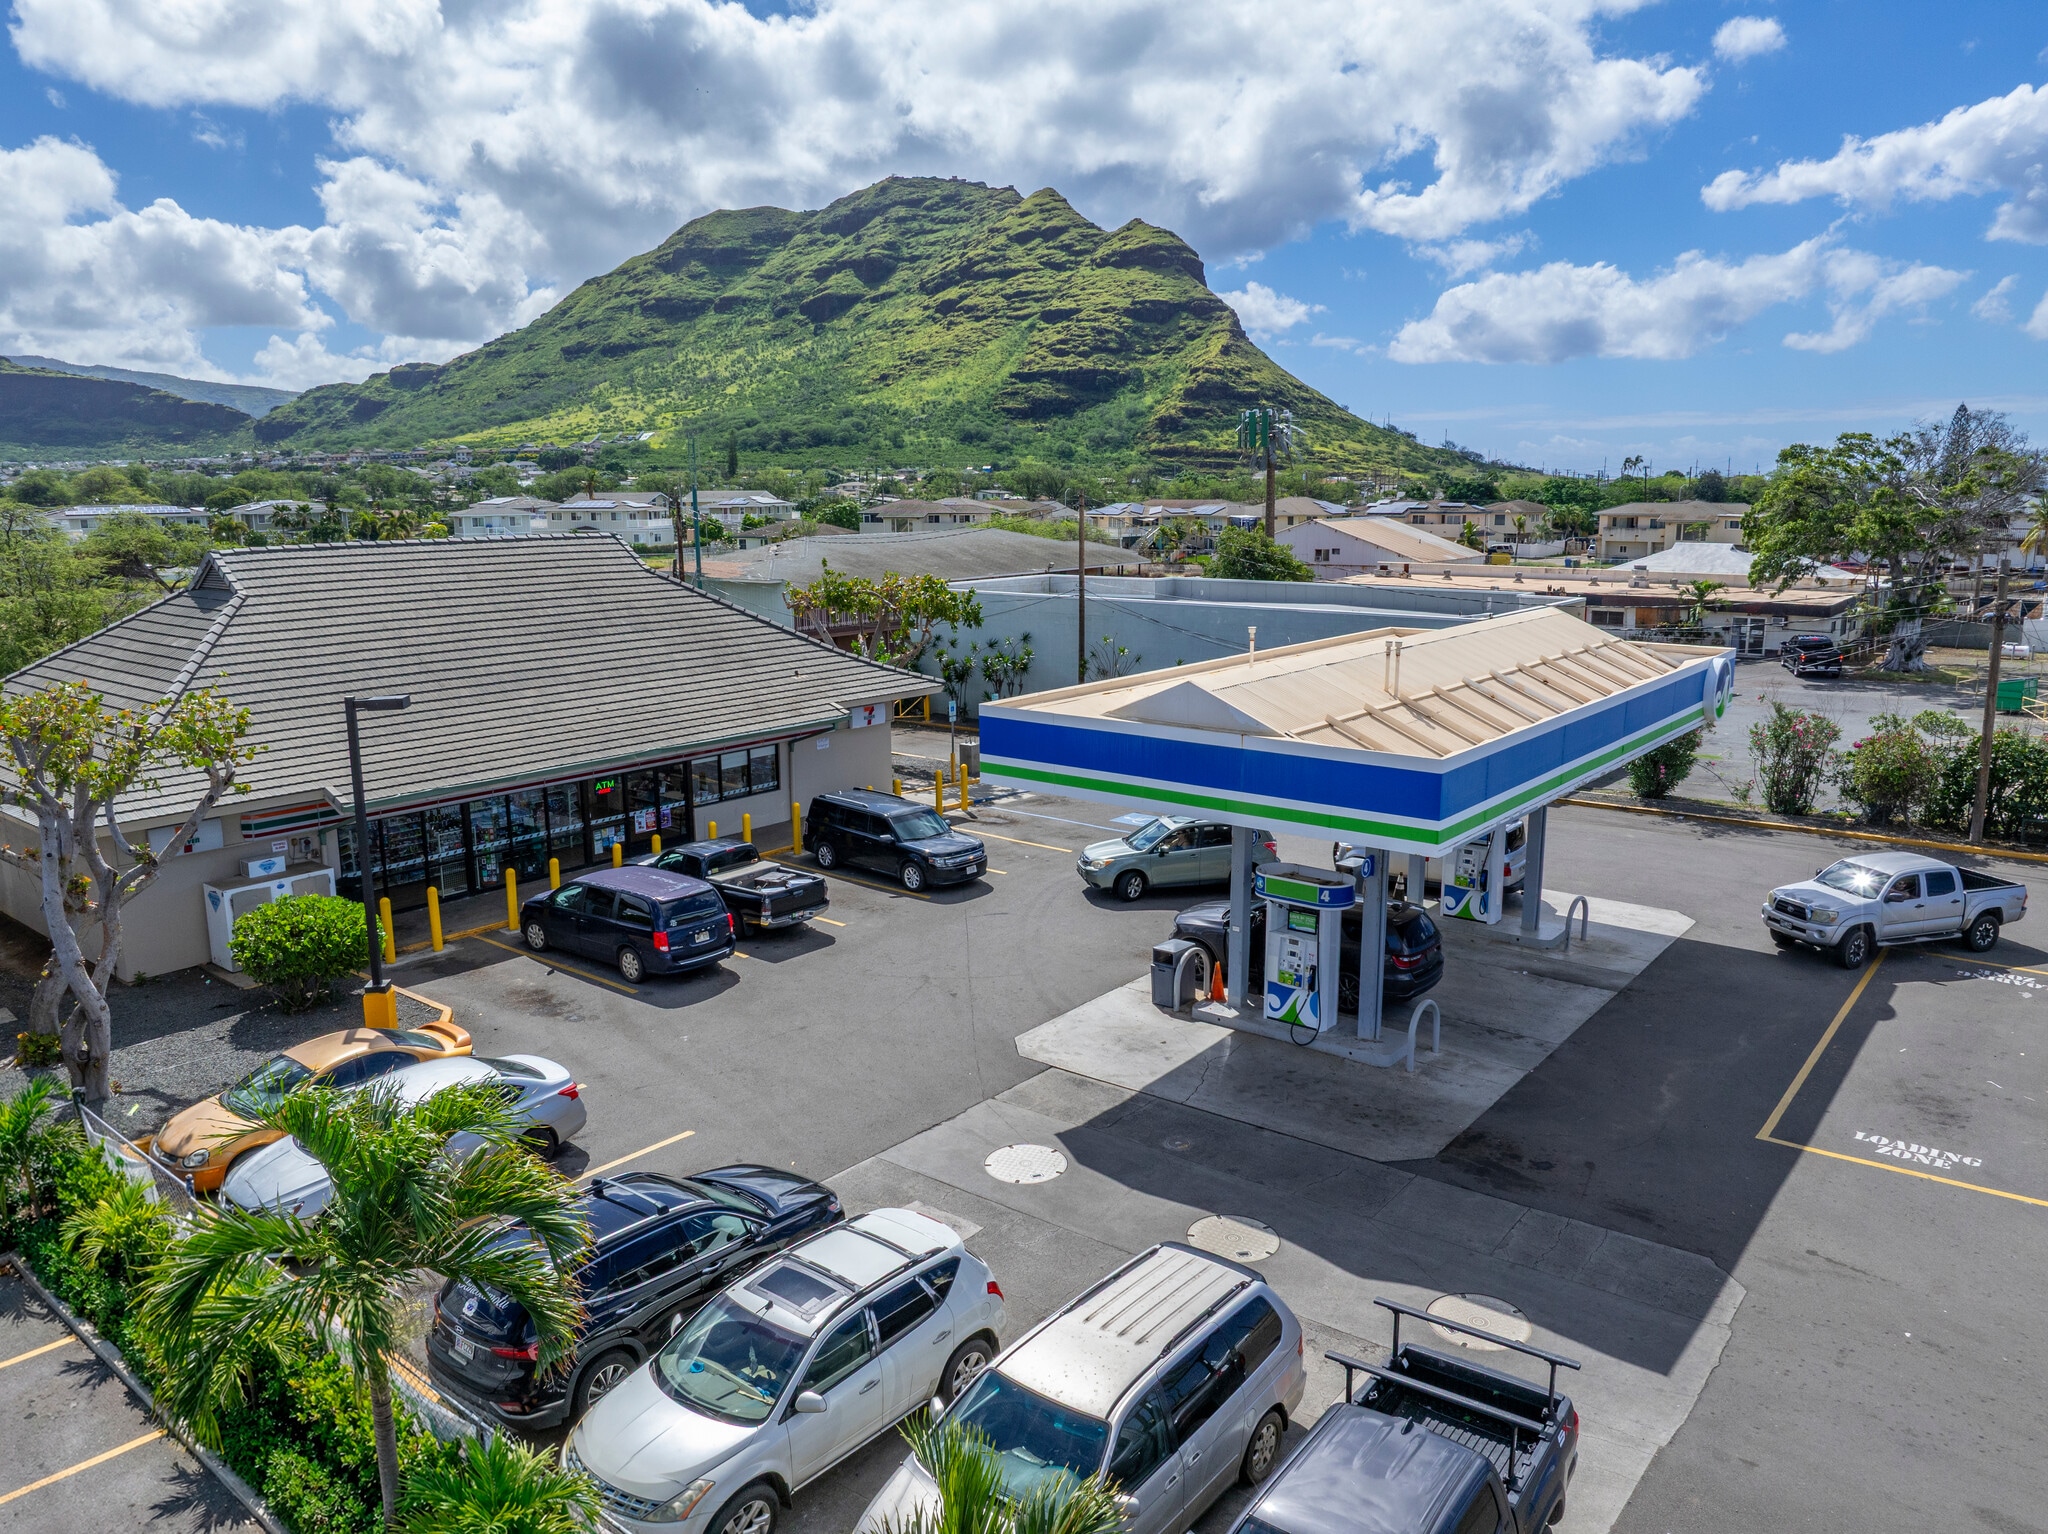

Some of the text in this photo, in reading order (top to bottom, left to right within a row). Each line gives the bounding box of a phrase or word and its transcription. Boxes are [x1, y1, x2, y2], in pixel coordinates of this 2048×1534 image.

[595, 780, 615, 790] ATM
[1320, 890, 1330, 902] 4
[1853, 1131, 1982, 1167] LOADING
[1874, 1145, 1952, 1169] ZONE
